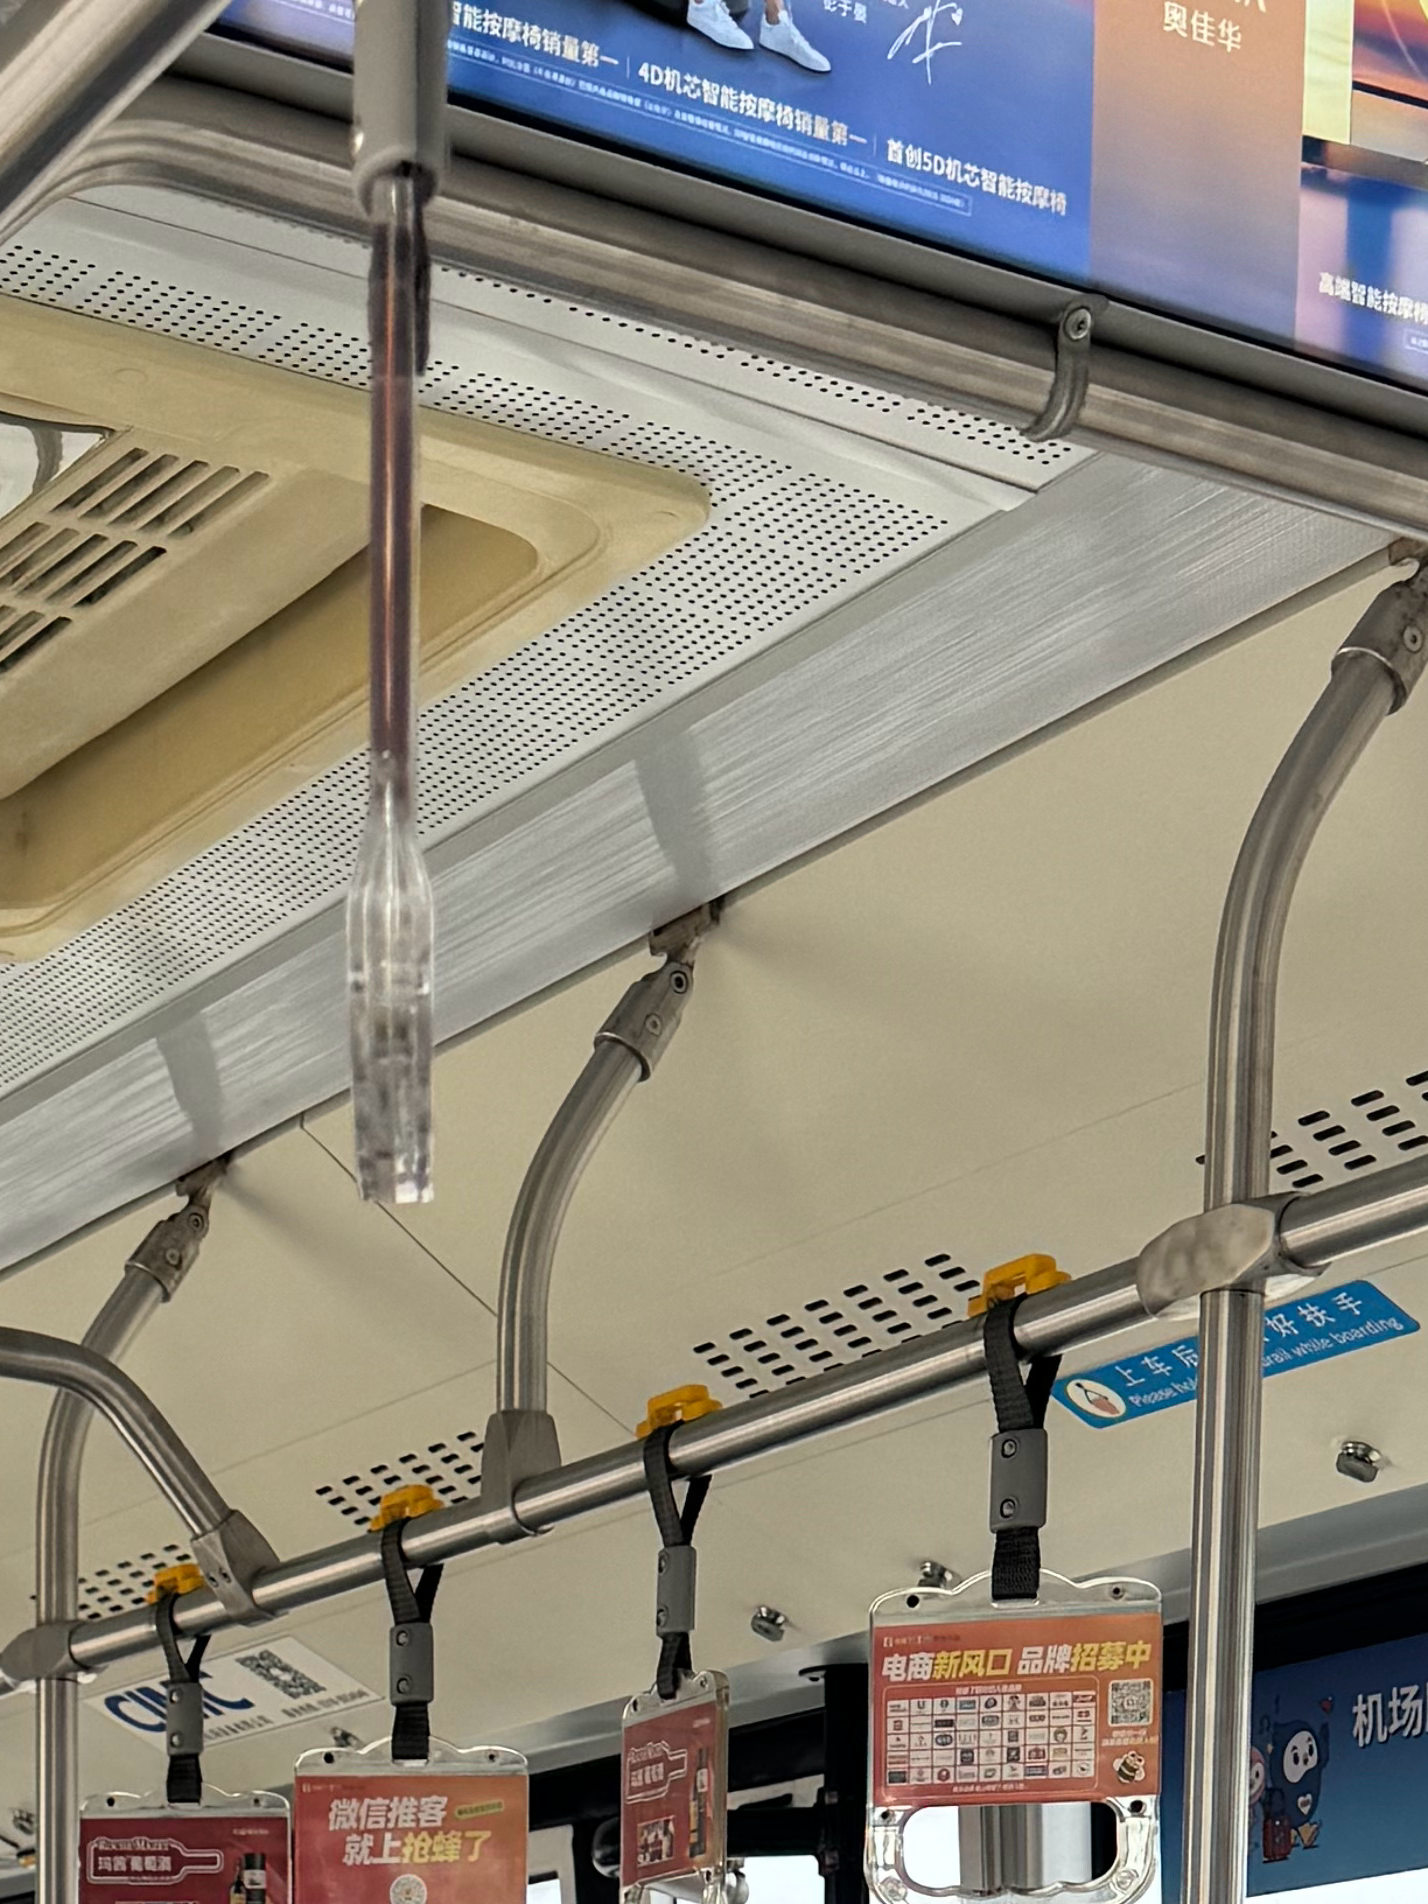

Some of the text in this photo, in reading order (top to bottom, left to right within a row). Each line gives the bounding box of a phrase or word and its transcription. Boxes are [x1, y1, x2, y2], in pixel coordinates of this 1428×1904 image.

[1163, 1, 1243, 53] 奥佳华
[638, 61, 868, 147] 4D机芯智能按摩椅销量第一
[886, 138, 1068, 217] 首创5D机芯智能按摩椅
[1115, 1291, 1363, 1388] 上车后好扶手
[1294, 1336, 1334, 1360] while
[1329, 1315, 1405, 1346] boarding
[882, 1640, 1153, 1682] 电商新风口 品牌招募中
[328, 1795, 449, 1831] 微信推客
[342, 1830, 492, 1866] 就上抢蜂了
